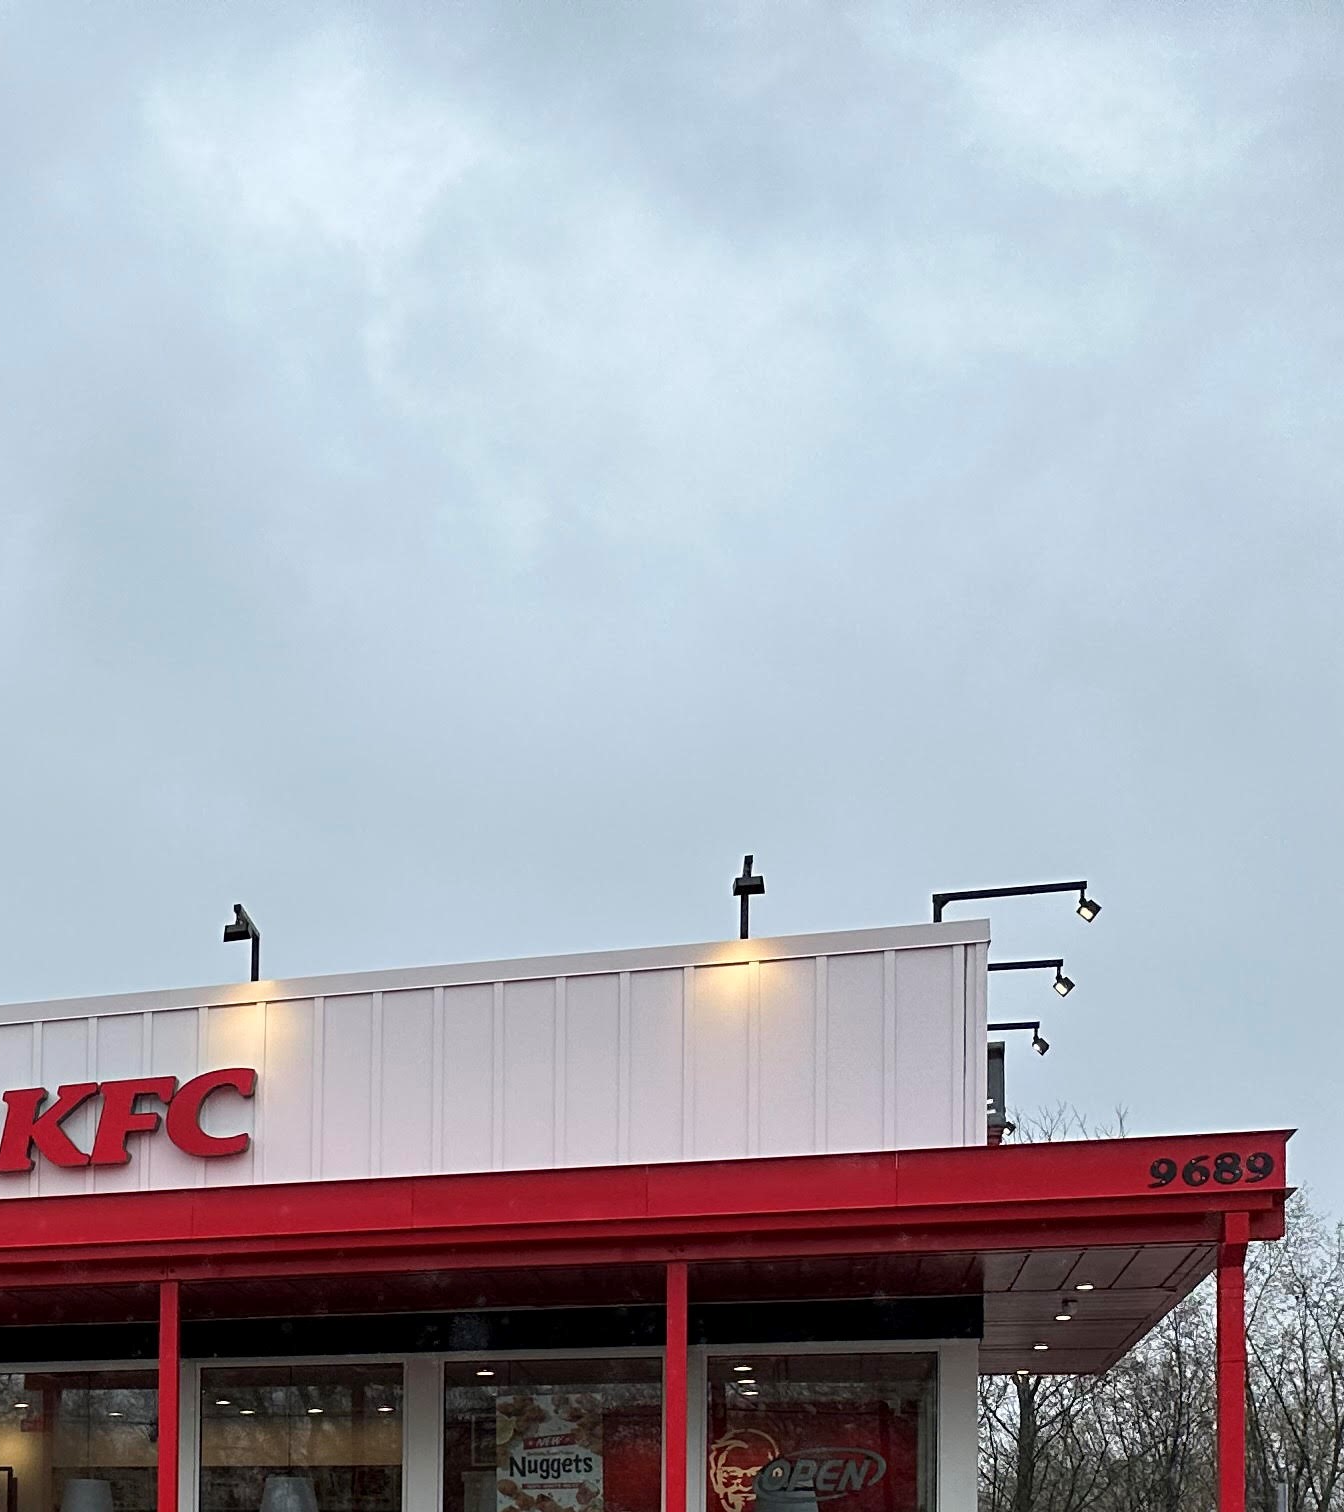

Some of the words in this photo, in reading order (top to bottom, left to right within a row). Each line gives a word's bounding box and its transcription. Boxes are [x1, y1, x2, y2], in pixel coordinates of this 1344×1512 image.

[1148, 1152, 1274, 1188] 9689
[509, 1454, 593, 1479] Nuggets
[763, 1459, 869, 1491] OPEN
